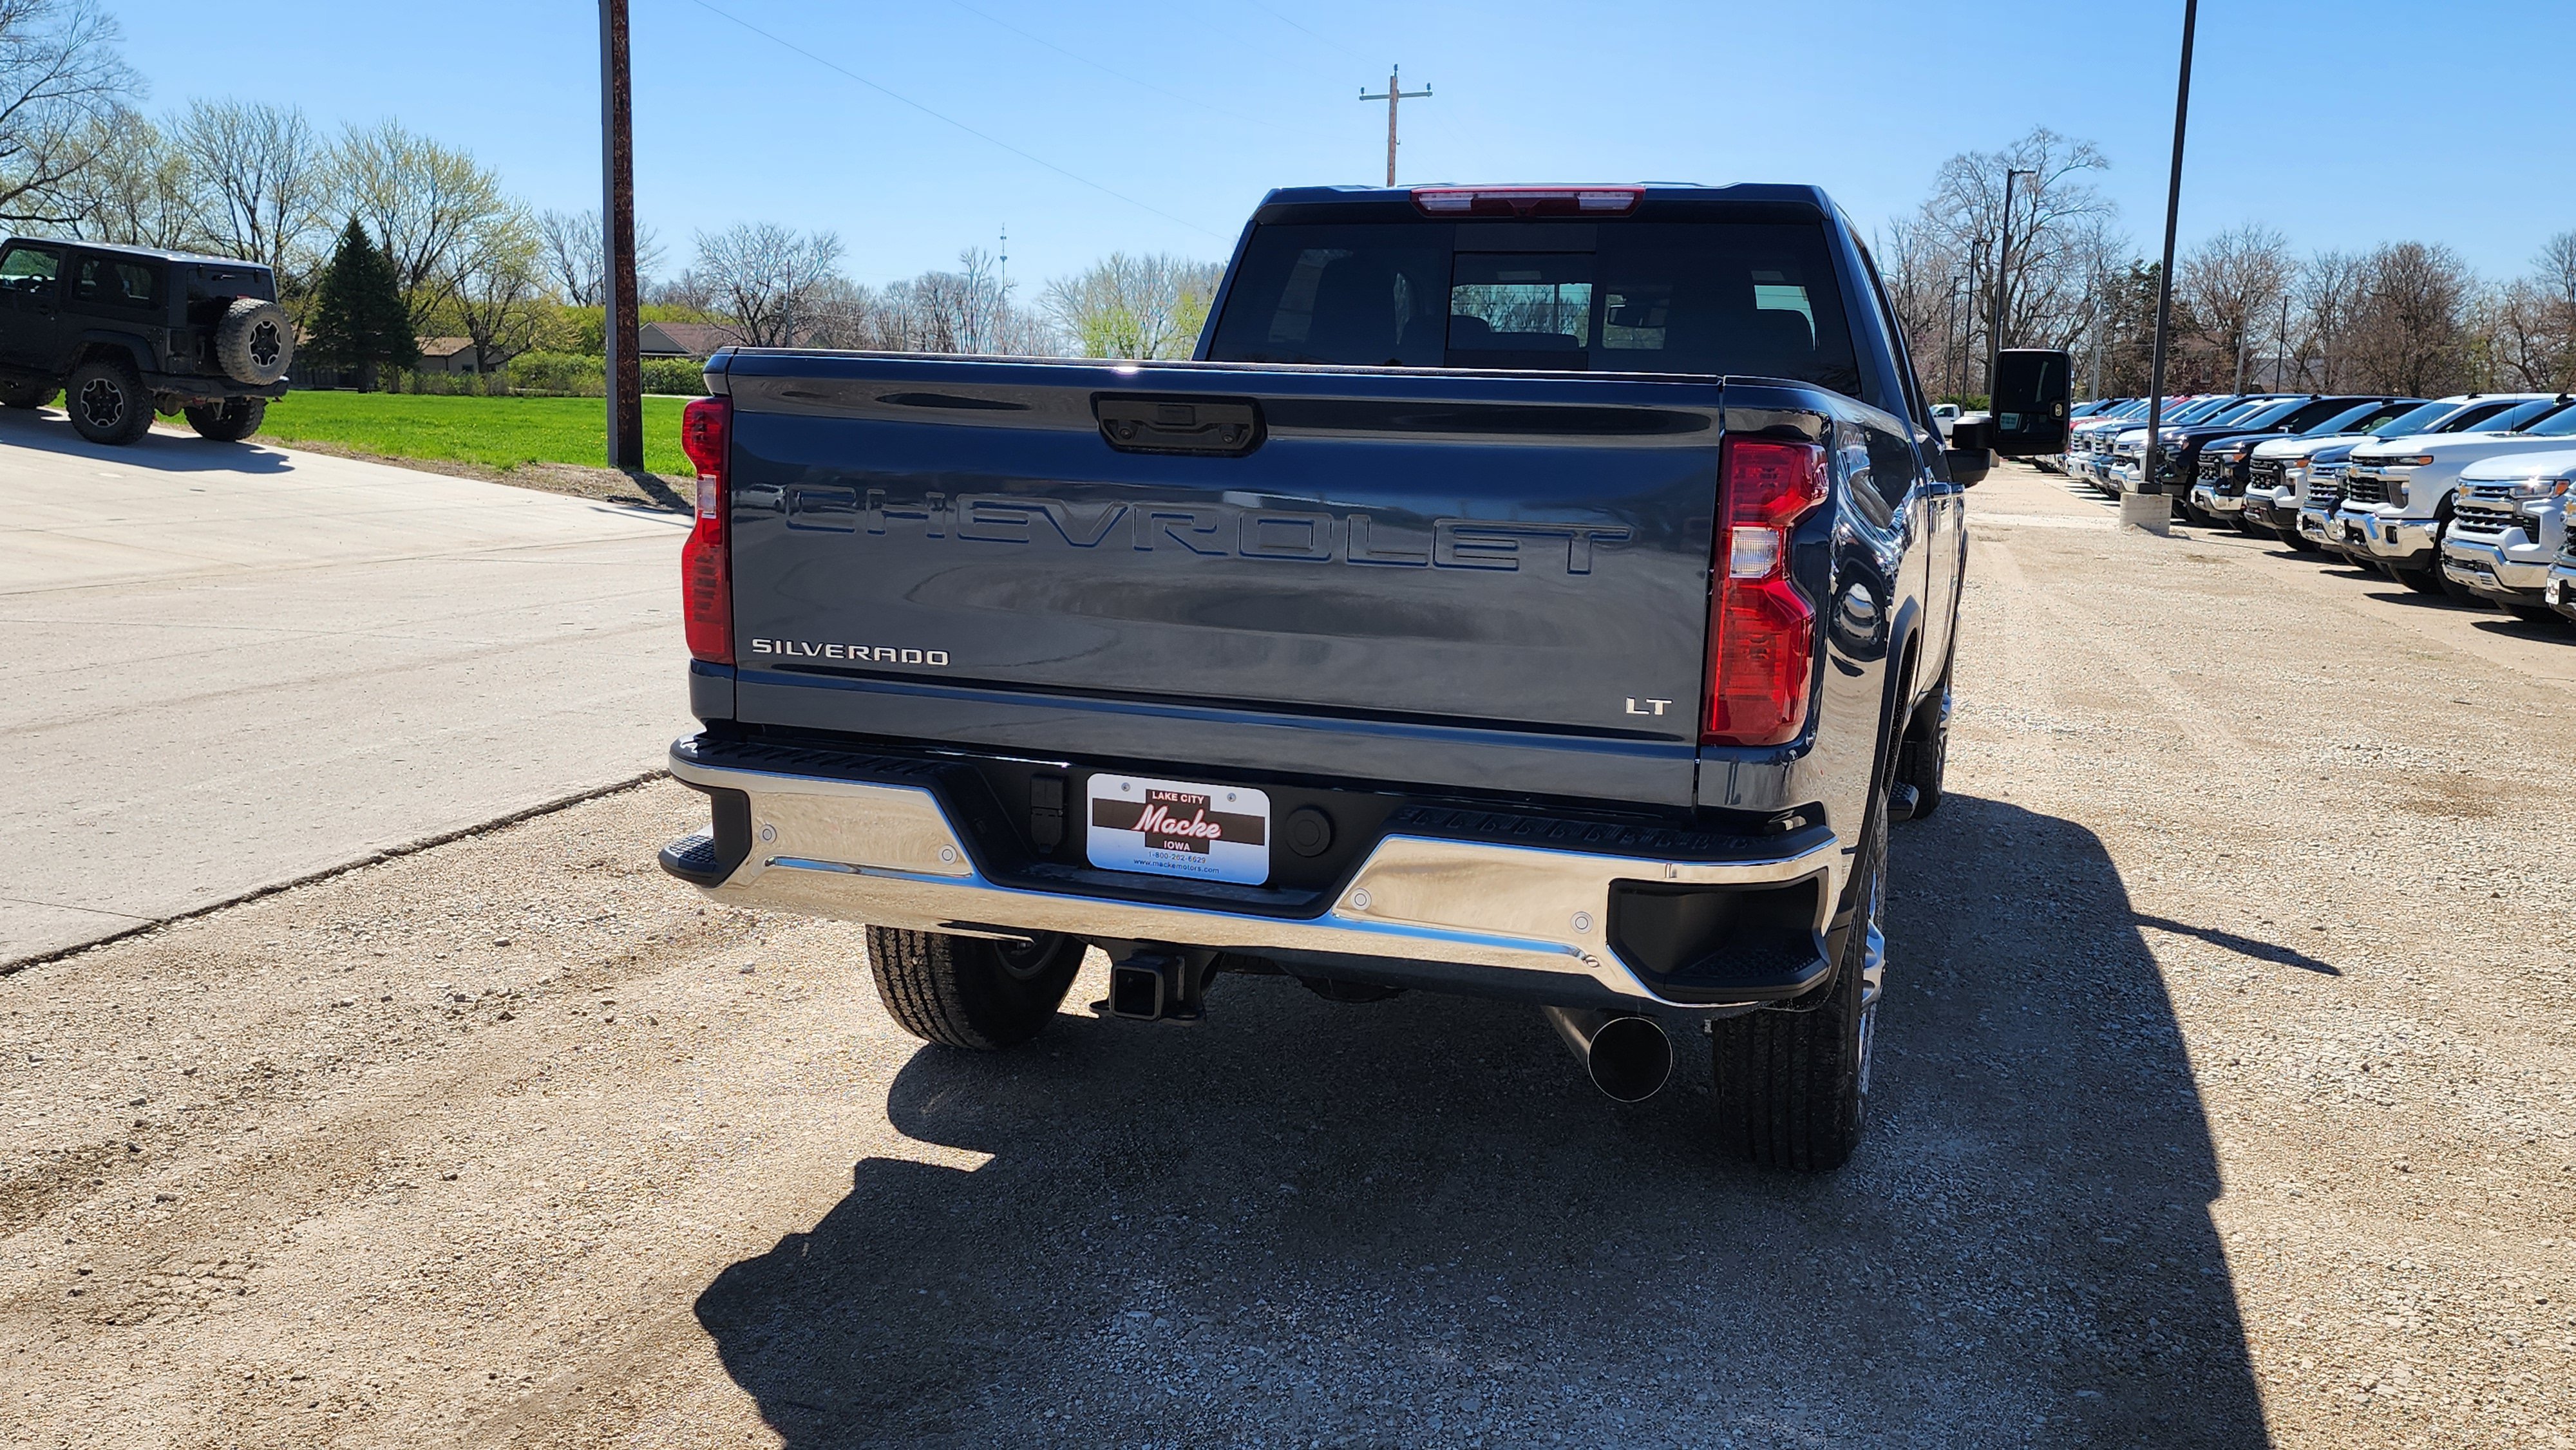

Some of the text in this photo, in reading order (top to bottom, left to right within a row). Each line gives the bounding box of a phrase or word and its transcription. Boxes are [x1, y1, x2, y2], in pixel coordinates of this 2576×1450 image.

[785, 484, 1633, 576] CHEVROLET
[752, 638, 950, 666] SILVERADO
[1625, 697, 1672, 715] LT
[1151, 791, 1204, 804] LAKE CITY
[1132, 804, 1221, 839] Macke
[1163, 840, 1190, 851] IOWA
[1133, 858, 1220, 874] www.mackemotors.com
